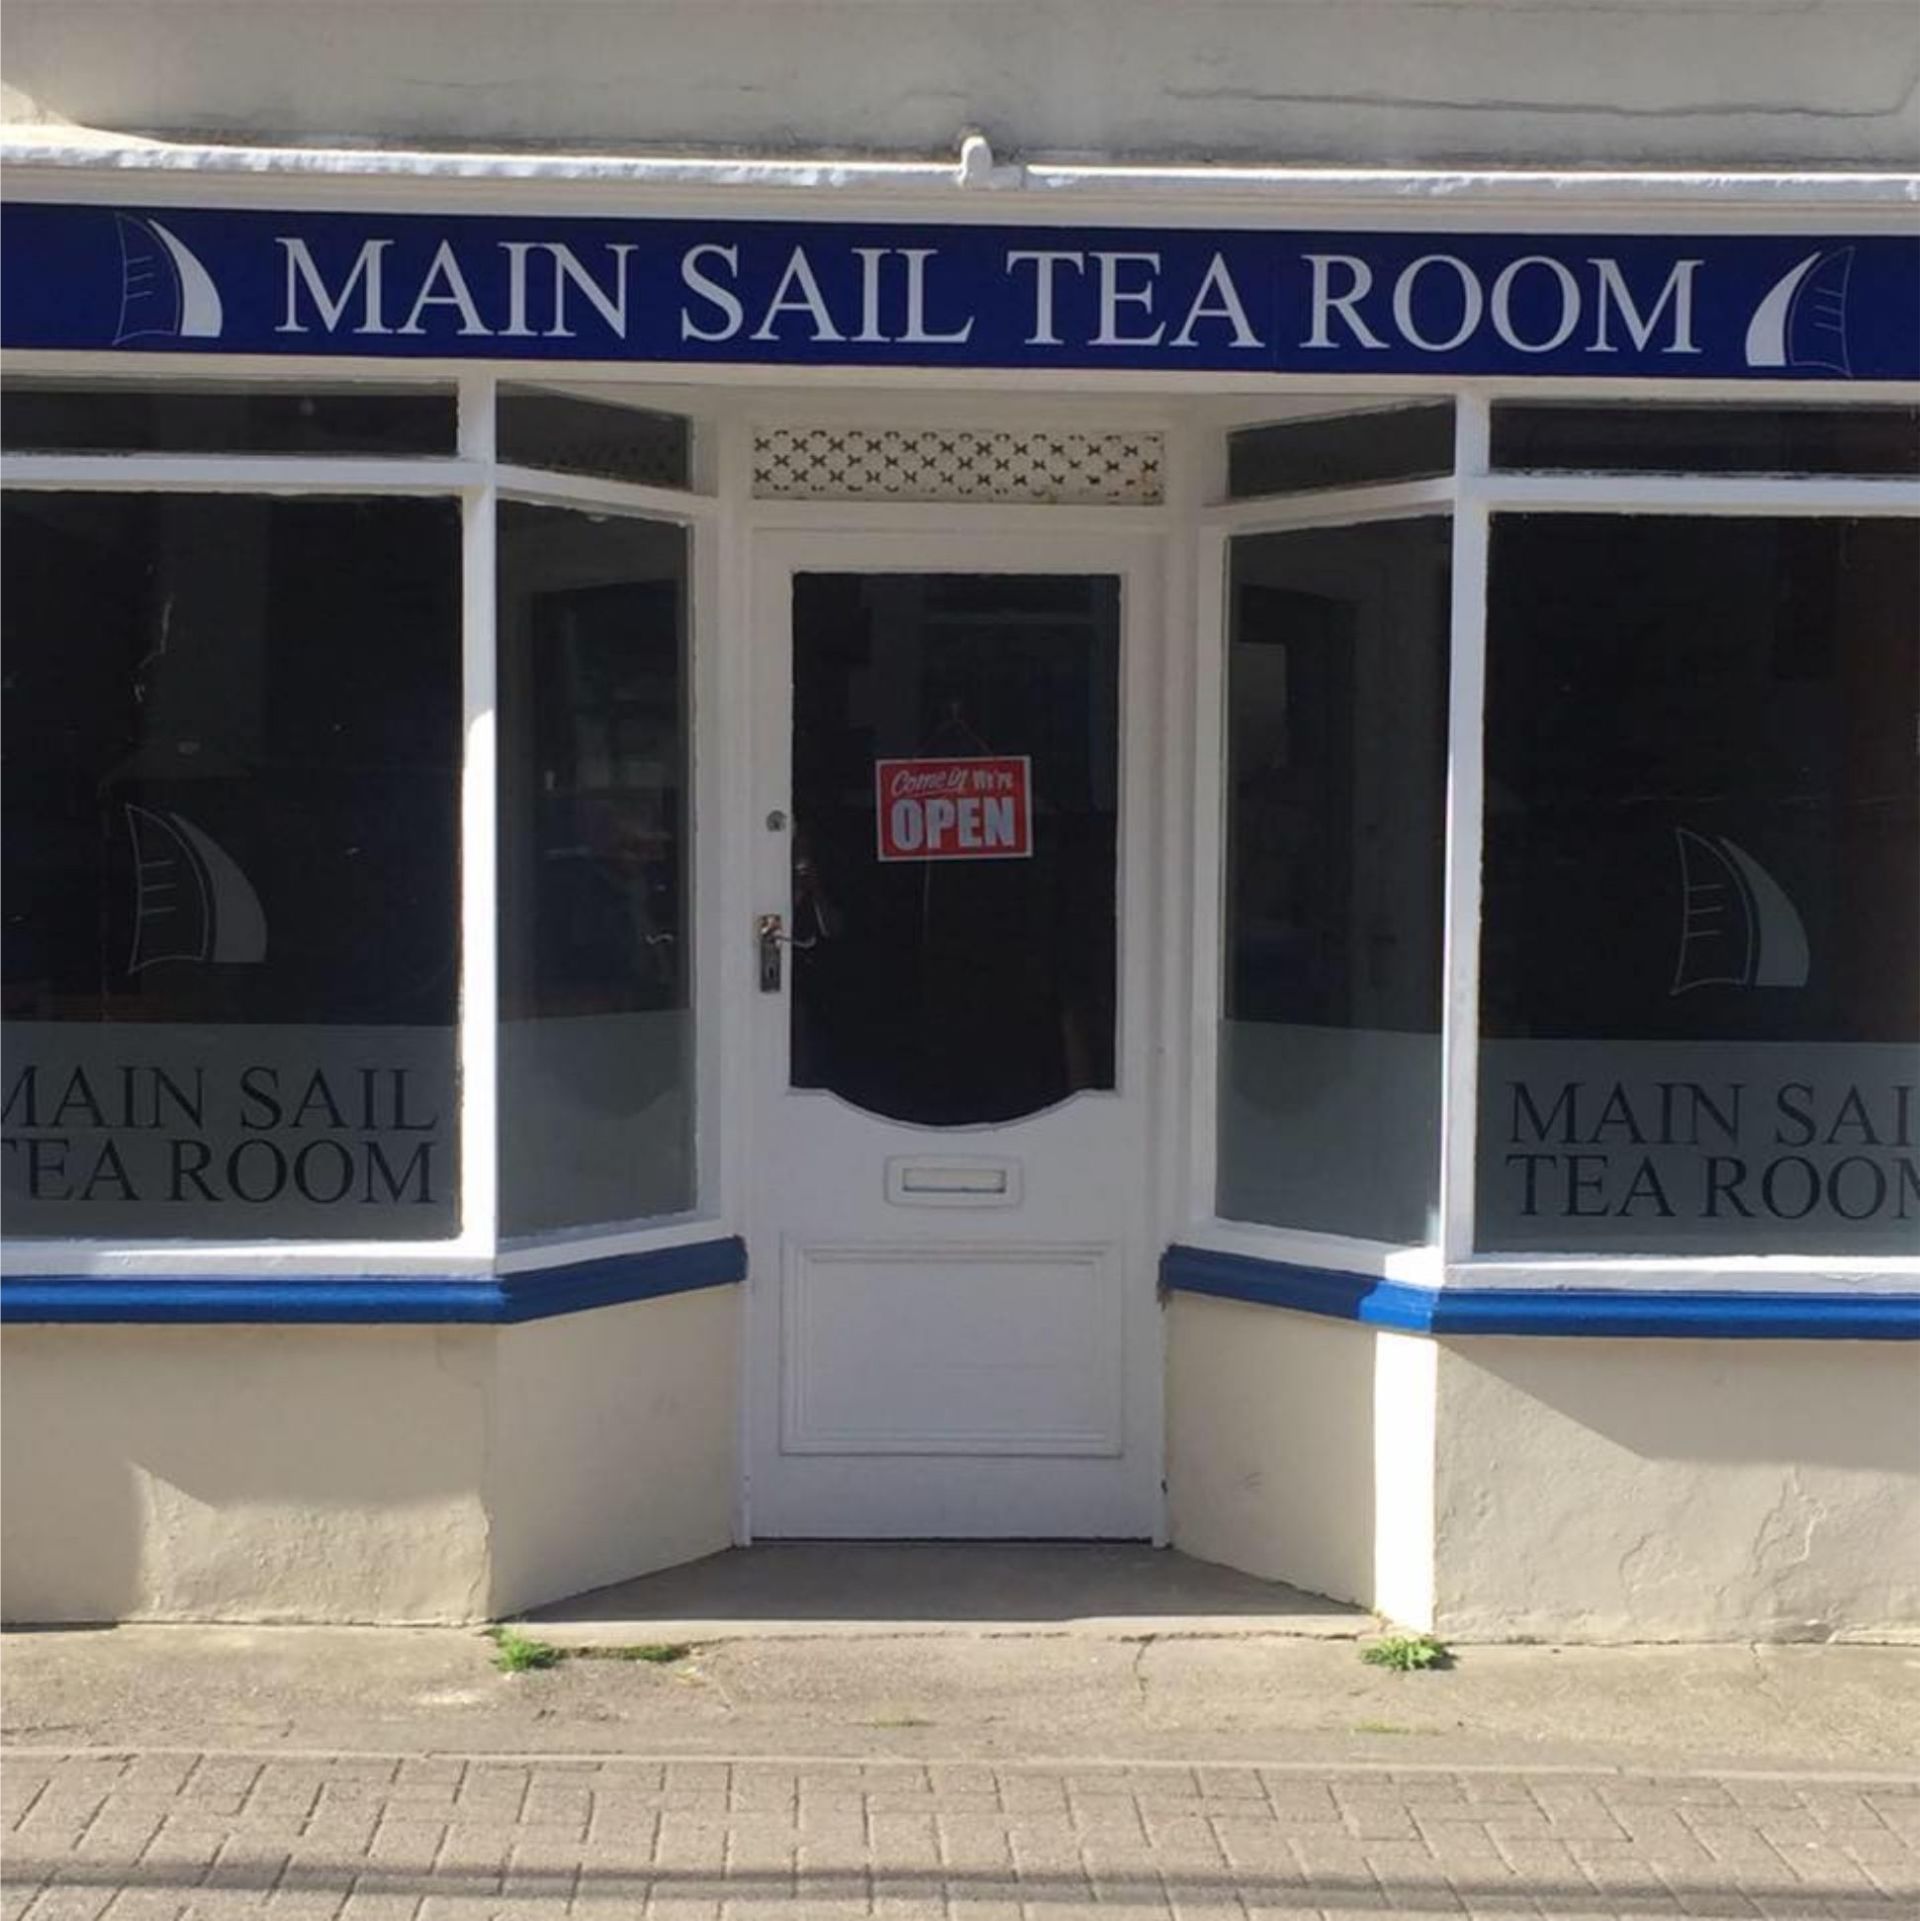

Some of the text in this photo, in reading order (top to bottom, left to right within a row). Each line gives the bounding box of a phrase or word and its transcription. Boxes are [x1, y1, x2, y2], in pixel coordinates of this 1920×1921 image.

[275, 236, 1703, 354] MAIN SAIL TEA ROOM
[891, 769, 947, 798] Come
[891, 797, 1015, 850] OPEN
[239, 1066, 439, 1131] SAIL
[1506, 1081, 1746, 1145] MAIN
[168, 1138, 439, 1203] ROOM
[1505, 1153, 1676, 1217] TEA
